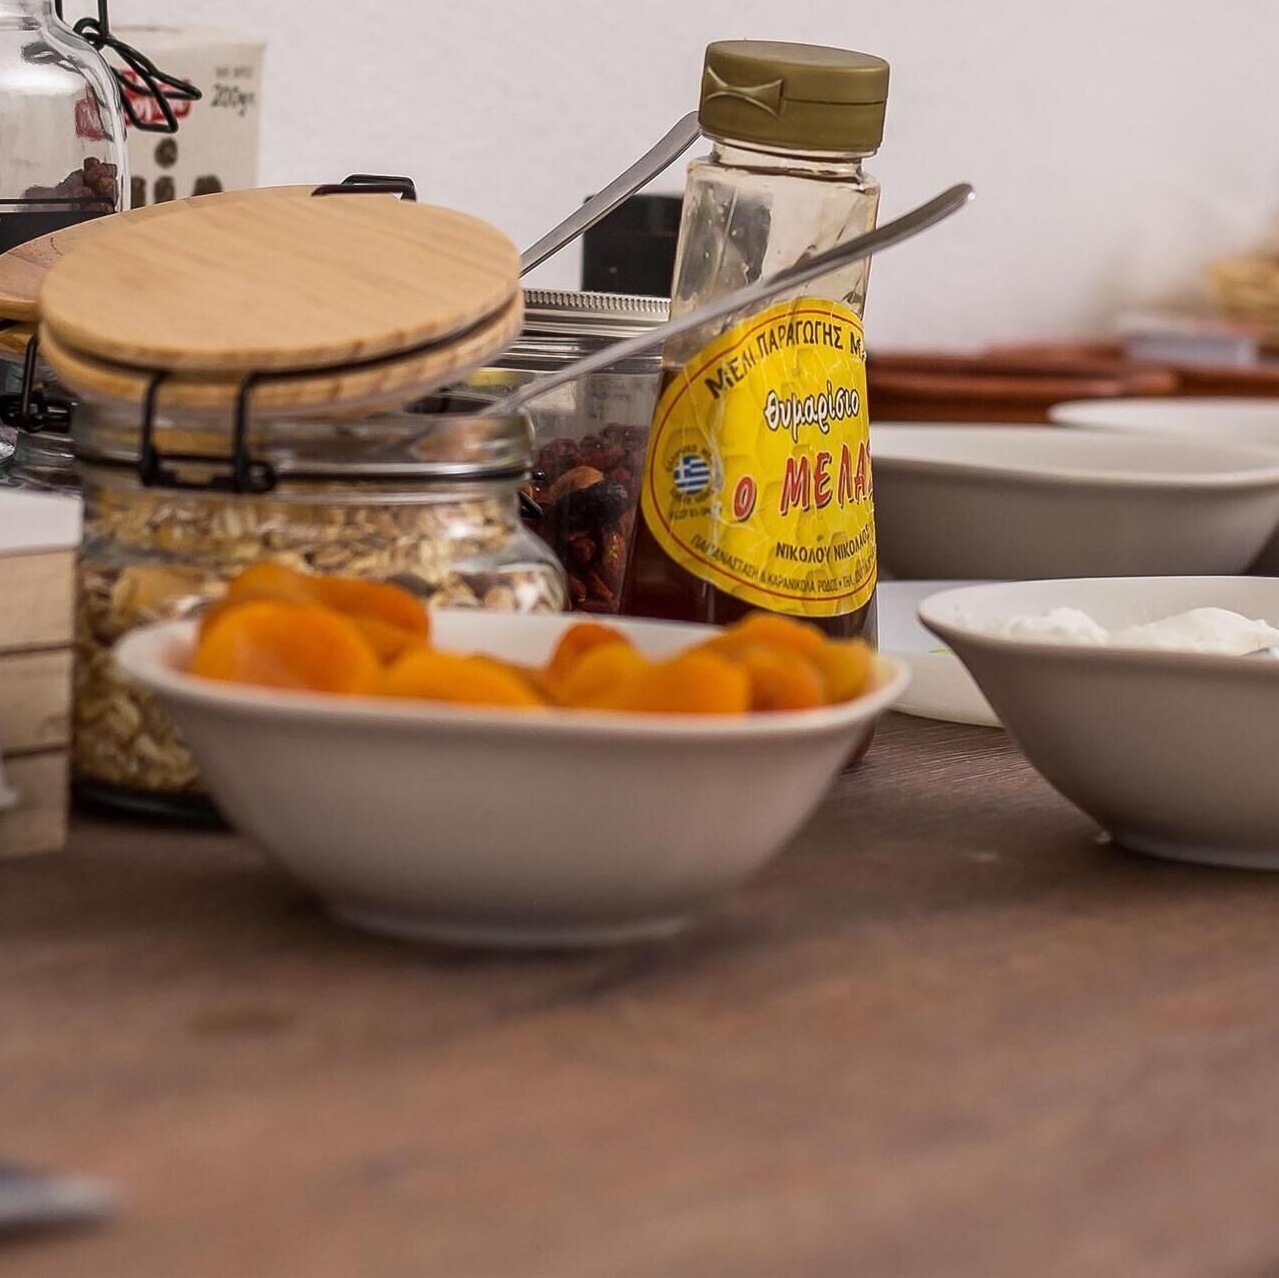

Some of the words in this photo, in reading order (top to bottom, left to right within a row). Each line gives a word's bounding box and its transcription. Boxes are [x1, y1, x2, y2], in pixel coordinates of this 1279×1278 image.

[704, 345, 757, 399] ΜΕΛΙ
[756, 320, 844, 359] ΠΑΡΑΓΩΓΗΣ
[733, 475, 757, 522] Ο
[780, 439, 874, 516] ΜΕΛΑ
[775, 541, 831, 563] ΝΙΚΟΛΟΥ
